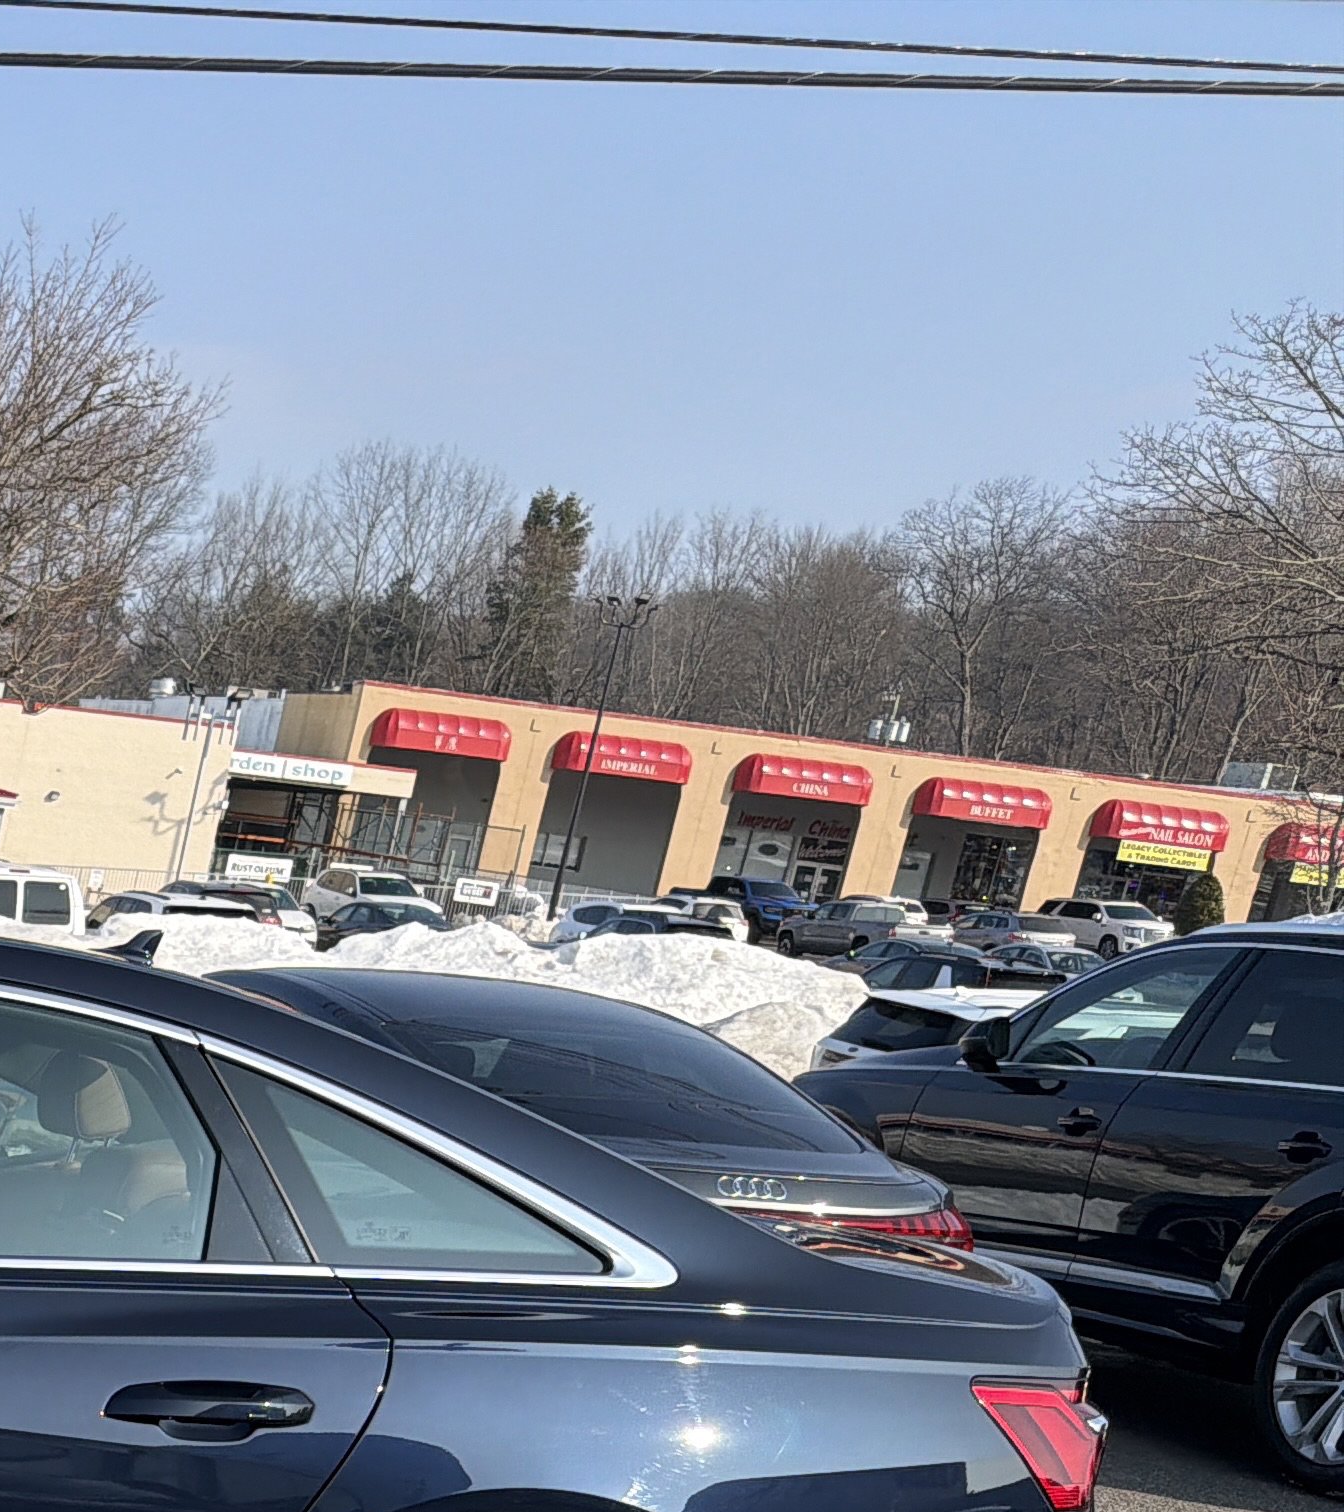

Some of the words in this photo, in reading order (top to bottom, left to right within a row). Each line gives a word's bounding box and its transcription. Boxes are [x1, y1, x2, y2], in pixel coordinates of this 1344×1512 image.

[292, 763, 344, 785] shop
[600, 758, 658, 776] IMPERIAL
[792, 781, 830, 797] CHINA
[969, 804, 1015, 820] BUFFET
[737, 810, 796, 832] Imperial
[808, 820, 851, 839] China
[1149, 827, 1175, 843] NAIL
[1176, 830, 1215, 847] SALON
